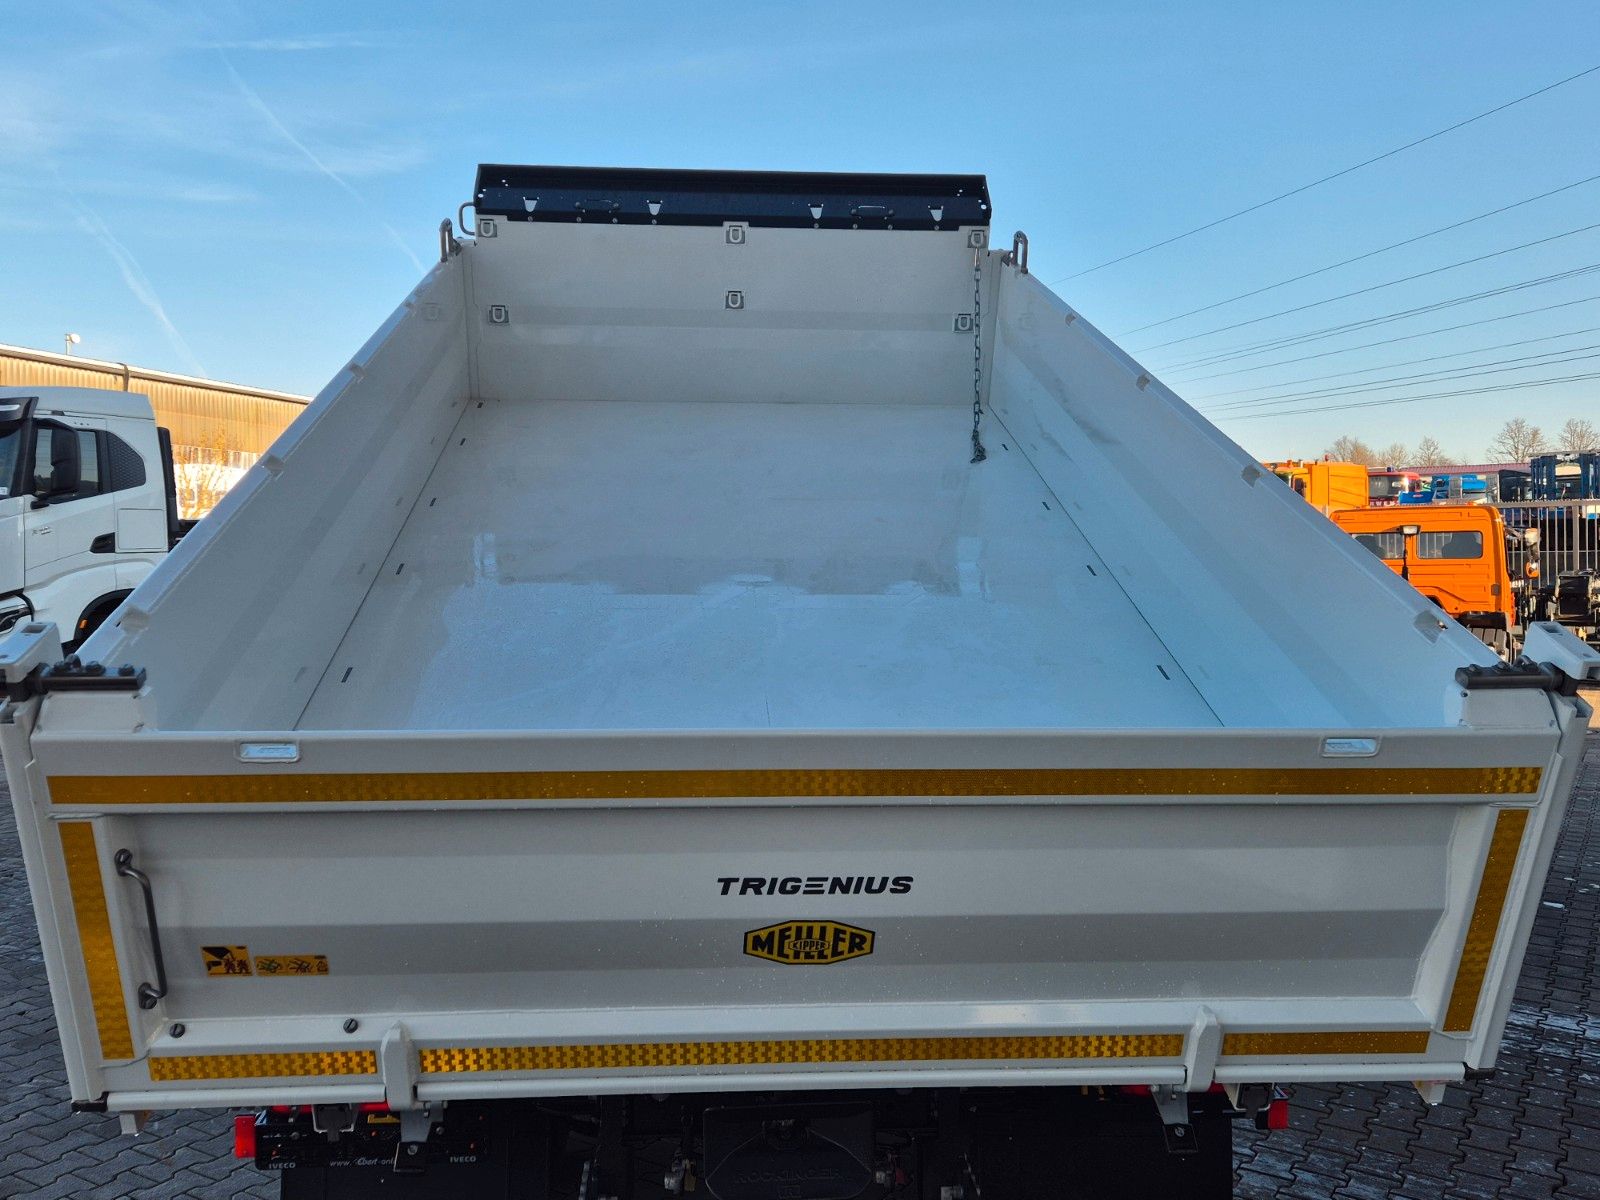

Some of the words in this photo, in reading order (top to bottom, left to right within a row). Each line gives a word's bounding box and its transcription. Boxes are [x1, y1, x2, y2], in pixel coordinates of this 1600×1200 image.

[717, 876, 914, 896] TRIGENIUS
[751, 925, 868, 960] MEILLER
[791, 941, 826, 951] KIPPER
[449, 1156, 476, 1164] IVECO
